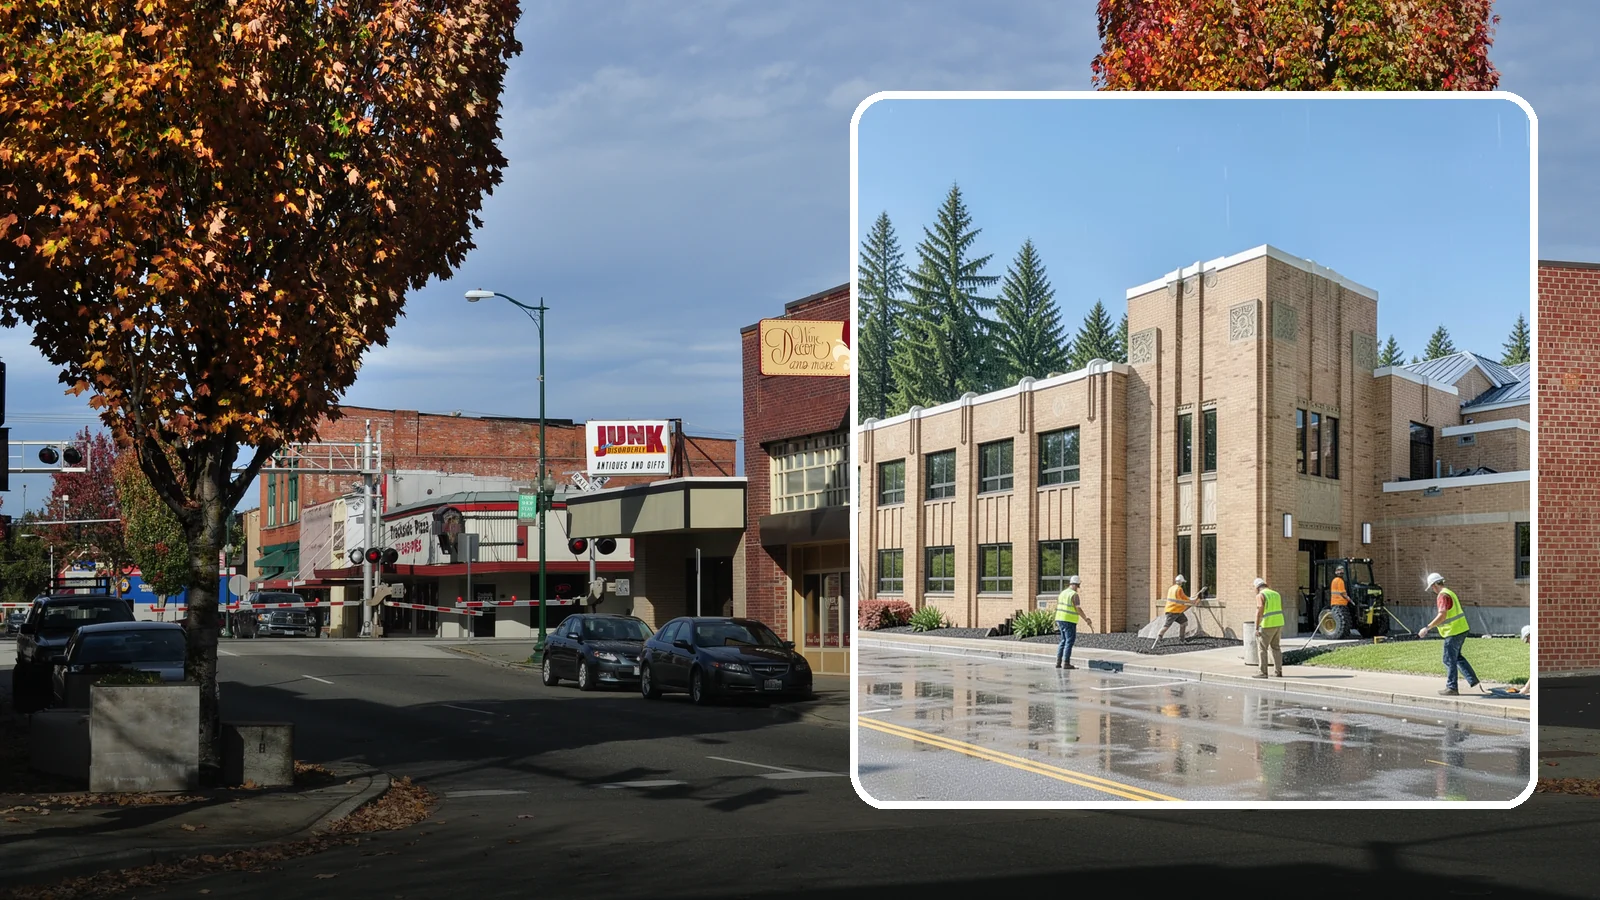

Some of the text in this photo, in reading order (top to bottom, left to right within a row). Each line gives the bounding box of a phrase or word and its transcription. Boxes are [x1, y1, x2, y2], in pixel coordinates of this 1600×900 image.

[595, 425, 664, 457] JUNK
[607, 446, 646, 454] DISORDERLY
[596, 460, 666, 470] ANTIQUES AND GIFTS
[414, 519, 429, 535] Pizza
